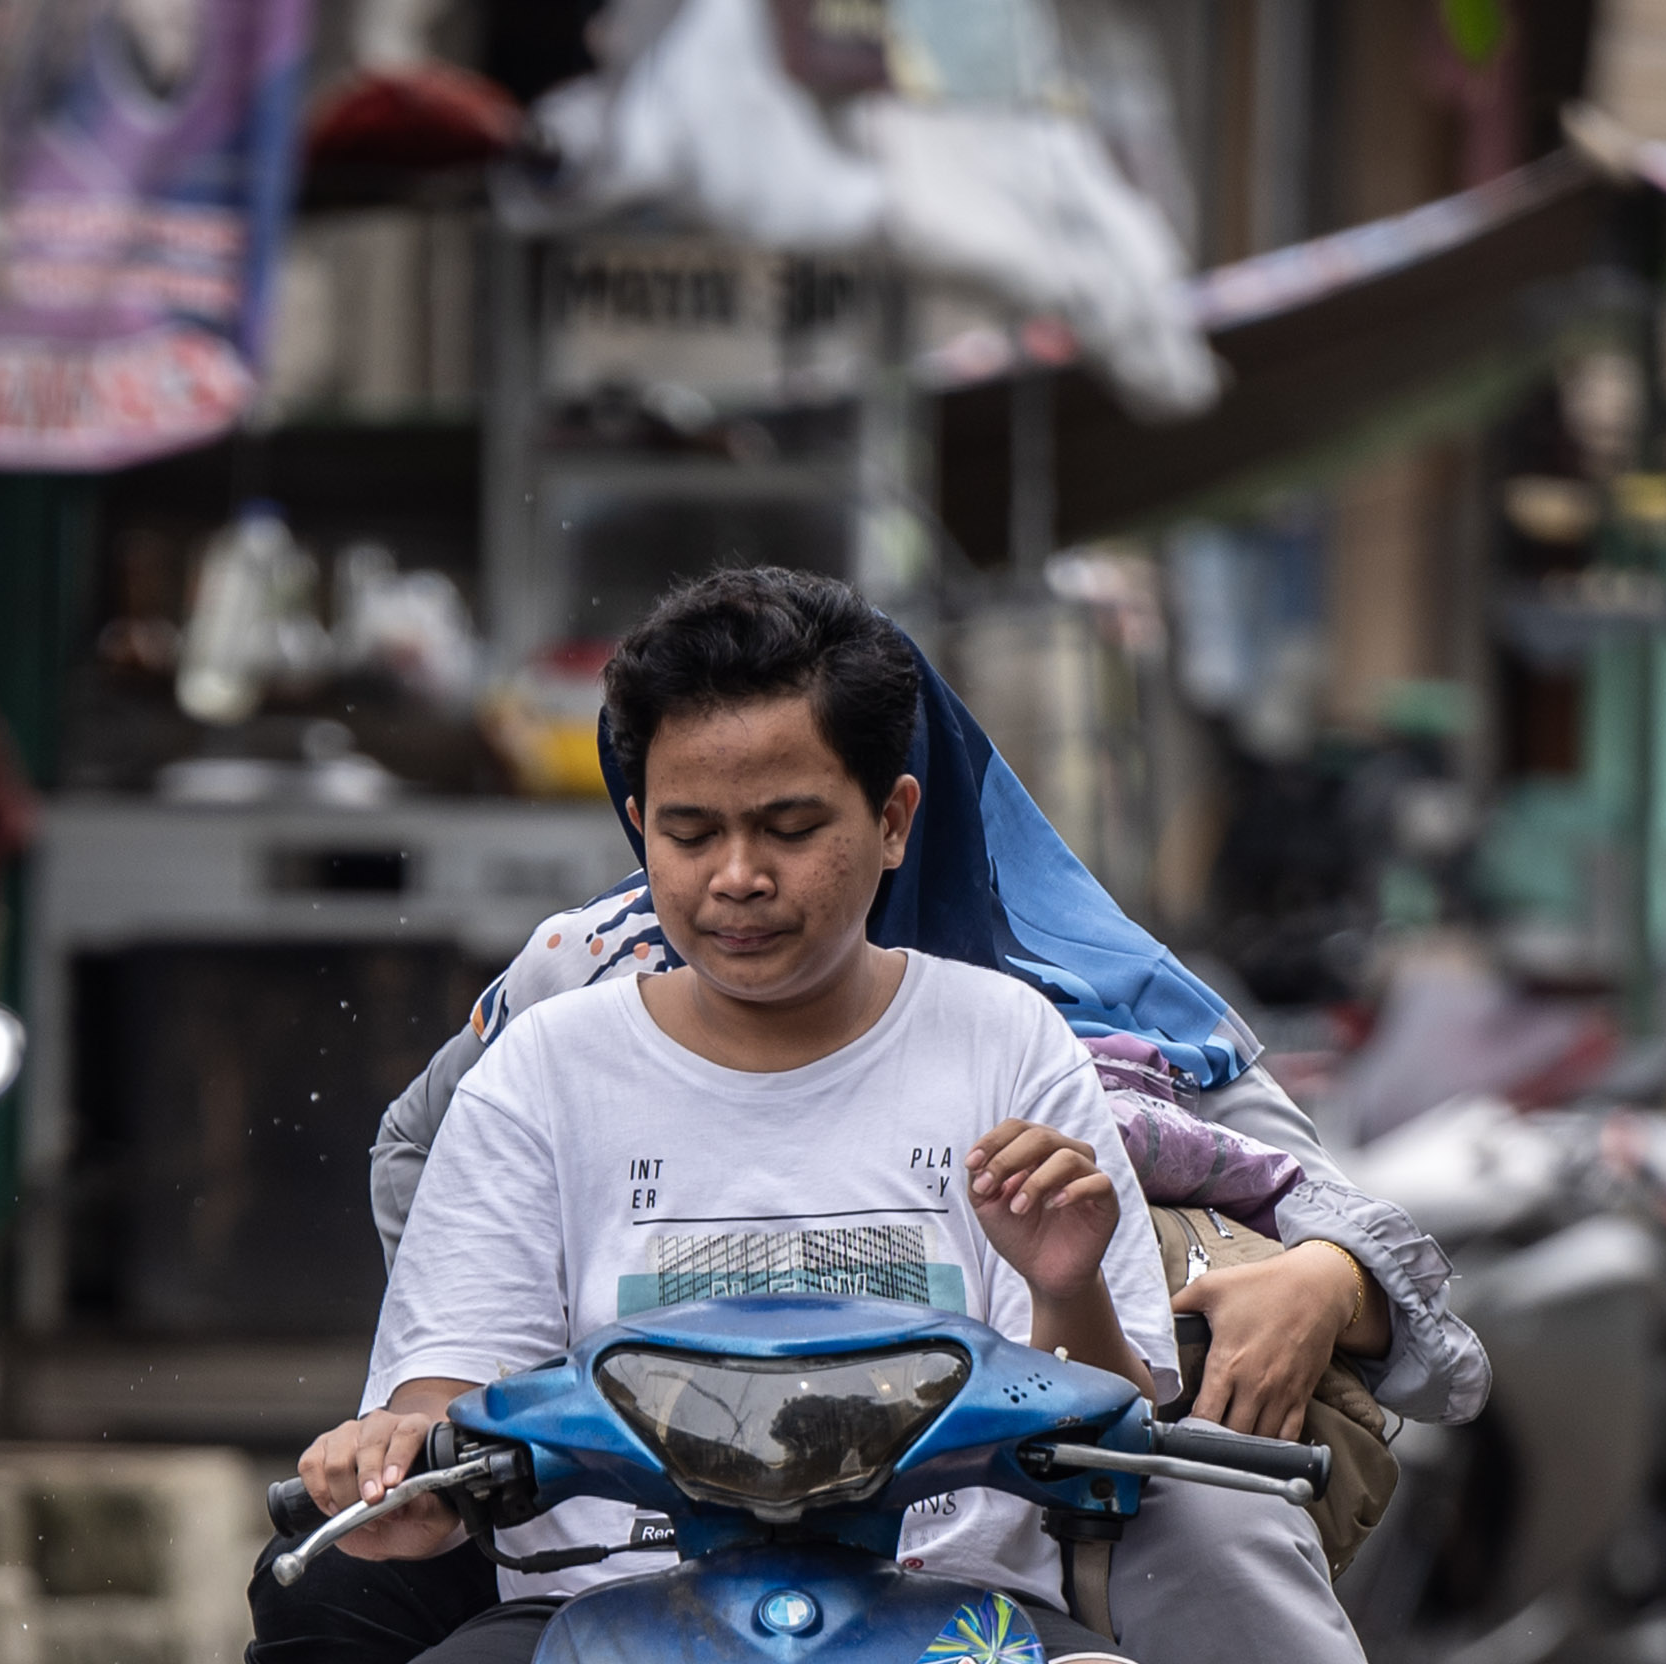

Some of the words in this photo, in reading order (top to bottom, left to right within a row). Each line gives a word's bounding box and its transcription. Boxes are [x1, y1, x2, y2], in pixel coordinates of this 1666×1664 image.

[910, 1147, 952, 1168] PLA
[629, 1159, 664, 1181] INT
[631, 1188, 658, 1209] ER
